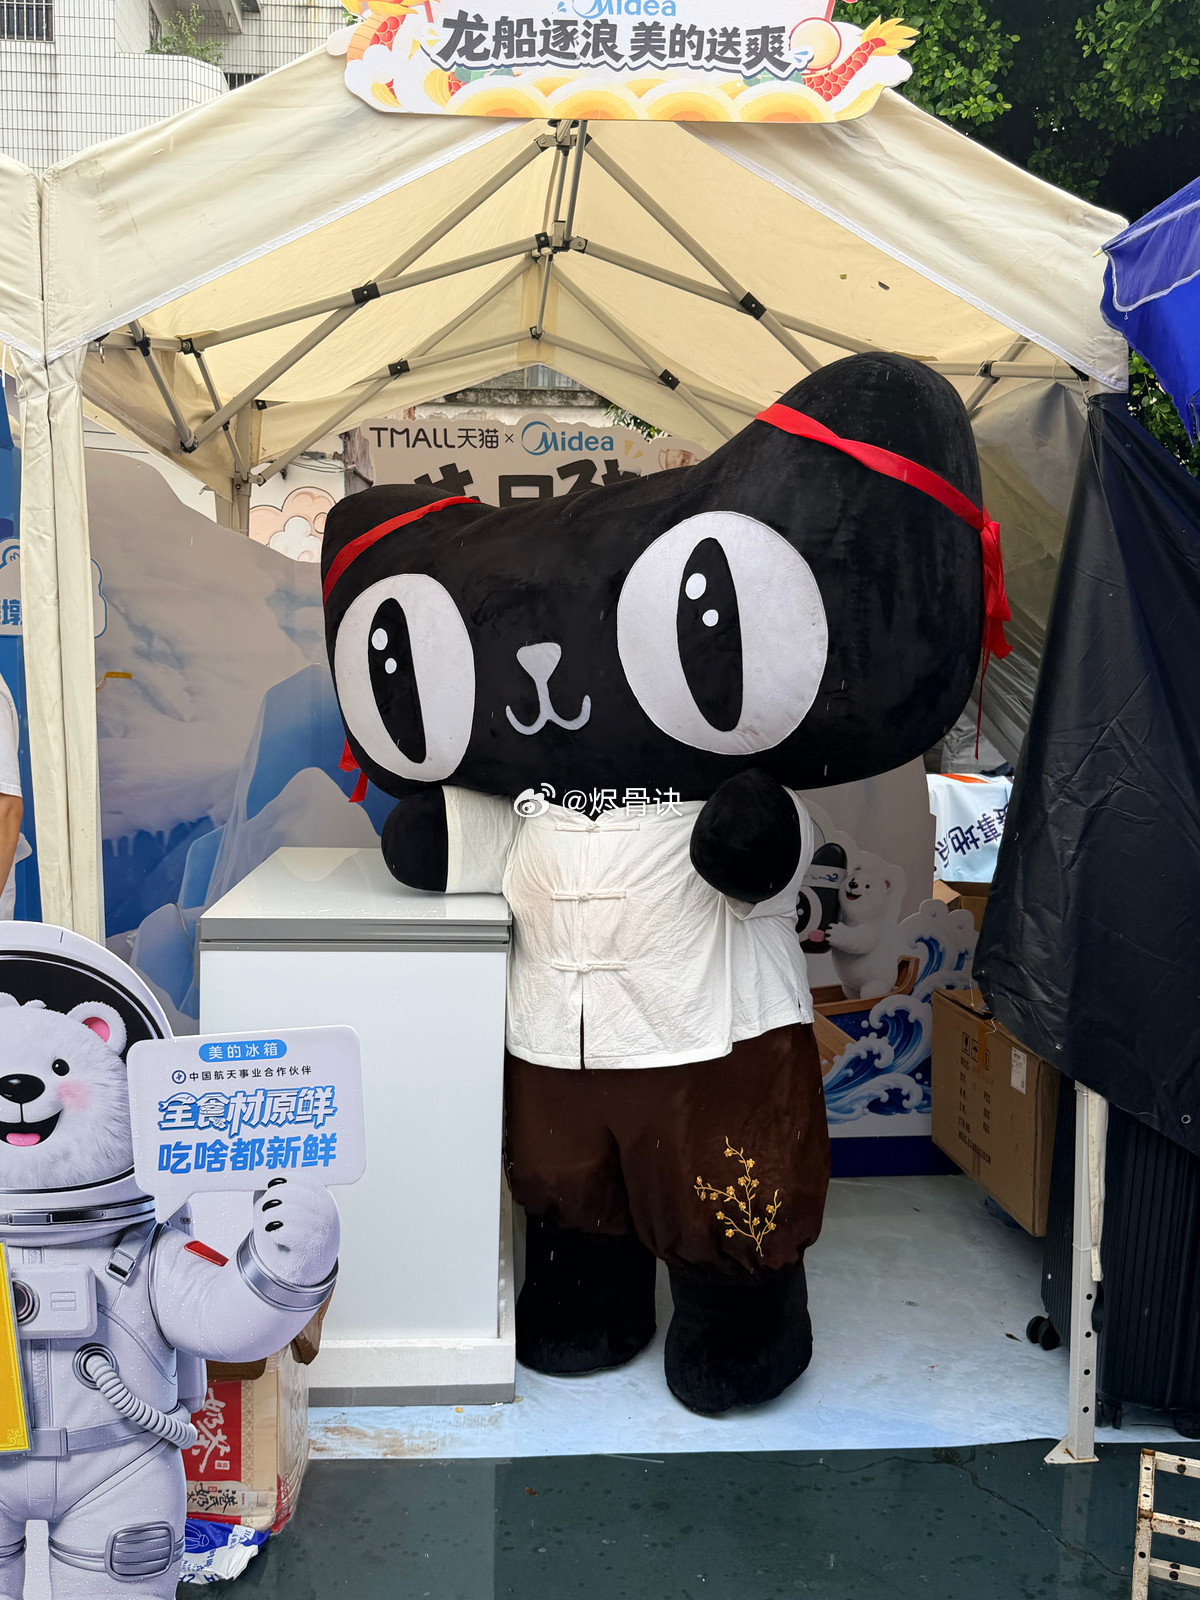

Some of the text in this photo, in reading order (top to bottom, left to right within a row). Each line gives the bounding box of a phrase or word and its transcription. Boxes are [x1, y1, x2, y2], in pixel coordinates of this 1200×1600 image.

[530, 428, 614, 453] Midea
[208, 1042, 279, 1060] 美的冰箱
[189, 1065, 312, 1082] 中国航天事业合作伙伴
[157, 1085, 338, 1139] 全食材原鲜
[158, 1132, 337, 1174] 吃啥都新鲜
